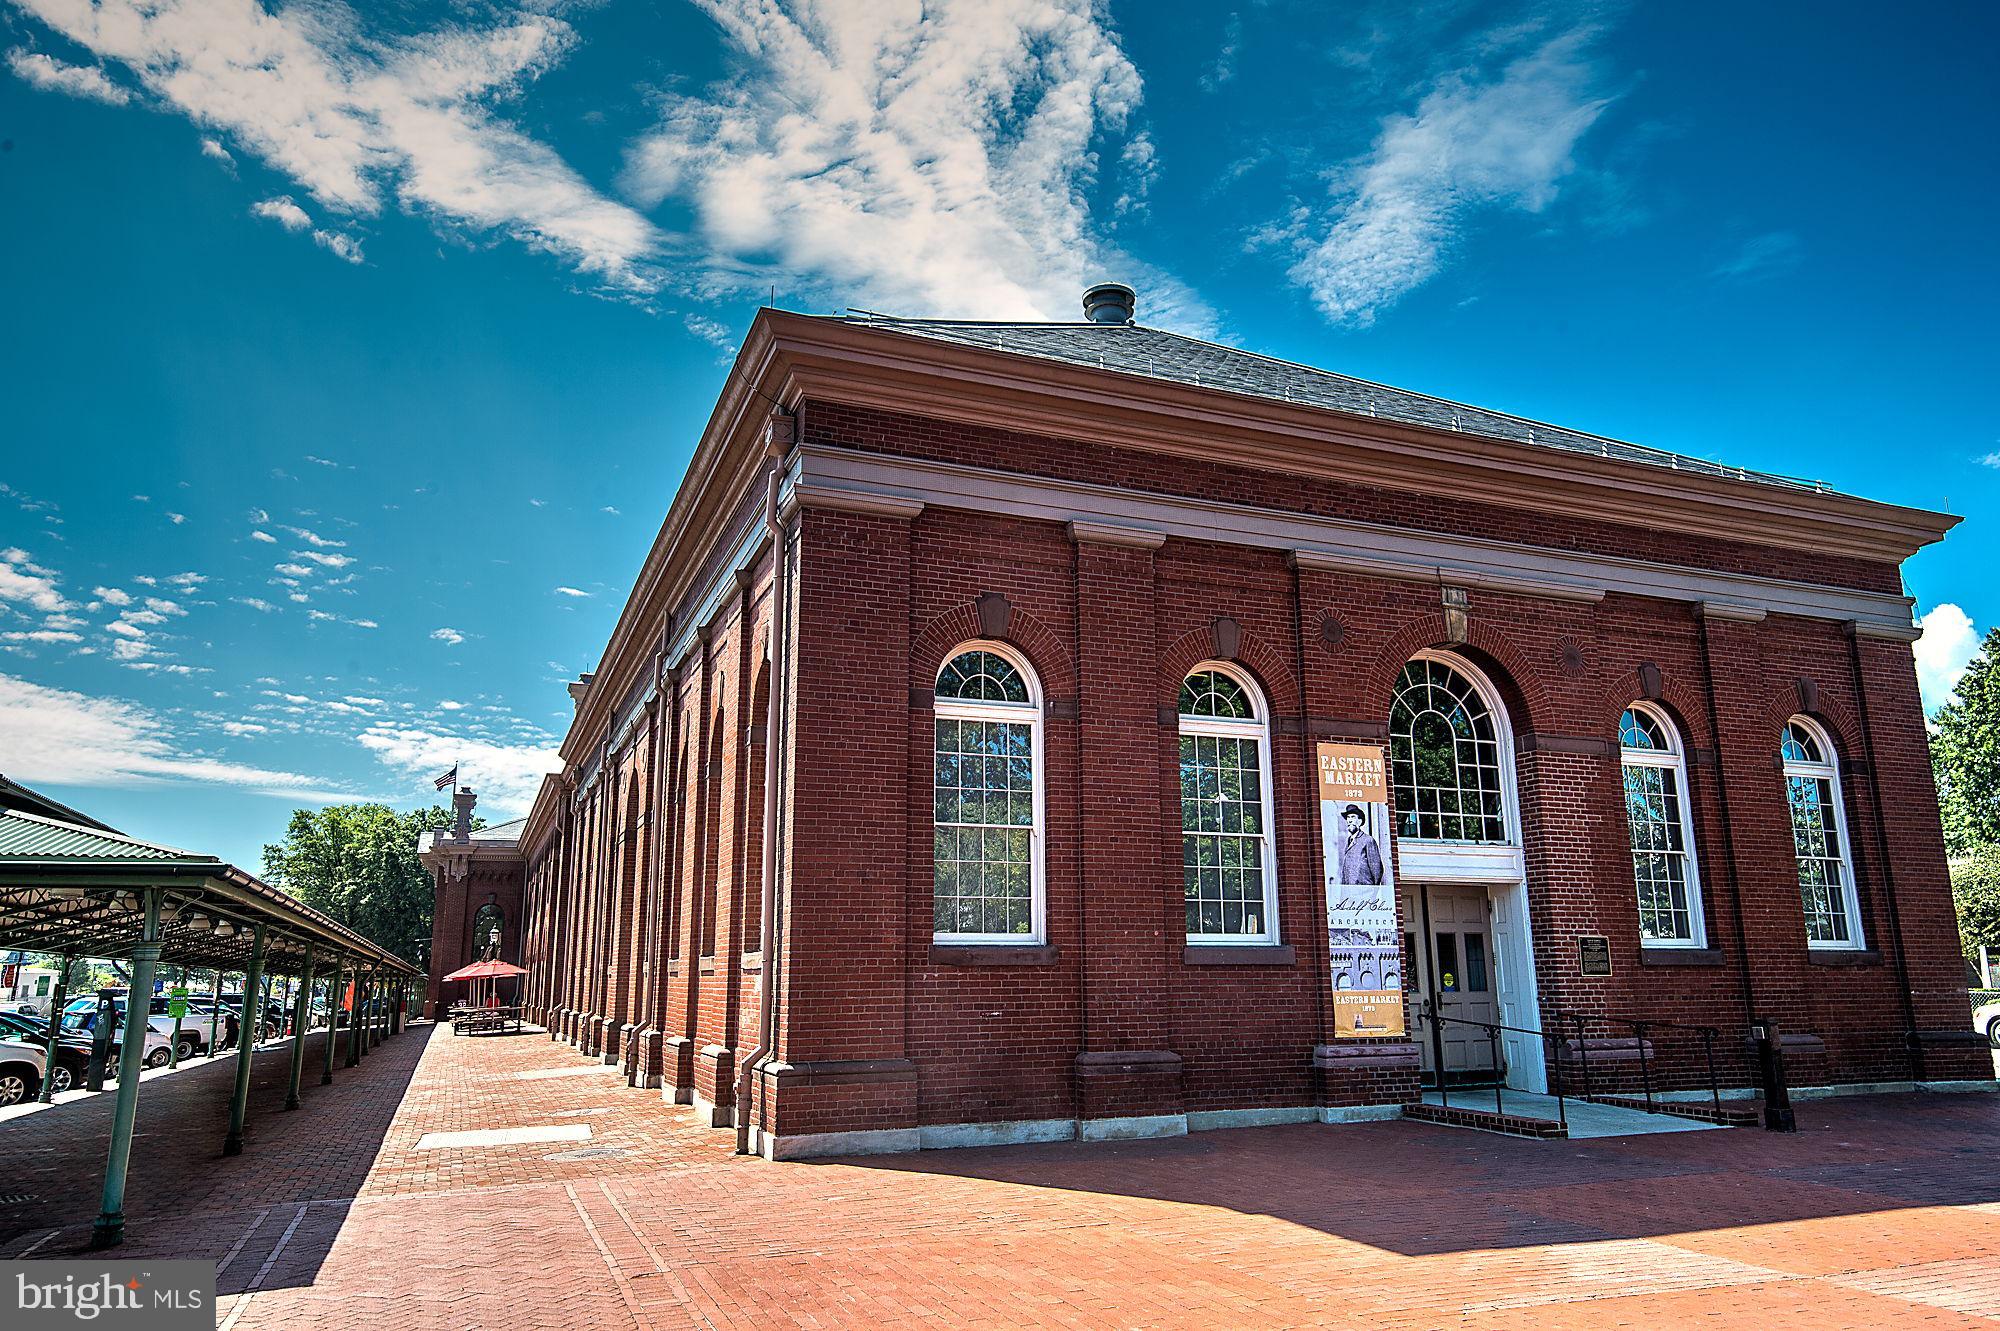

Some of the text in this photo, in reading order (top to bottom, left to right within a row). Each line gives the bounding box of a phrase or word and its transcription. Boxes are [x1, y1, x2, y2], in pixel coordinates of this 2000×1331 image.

[1320, 755, 1382, 773] EASTERN
[1324, 770, 1381, 787] MARKET
[1344, 789, 1363, 798] 1873
[101, 999, 109, 1010] P
[1335, 995, 1400, 1004] EASTERN MARKET
